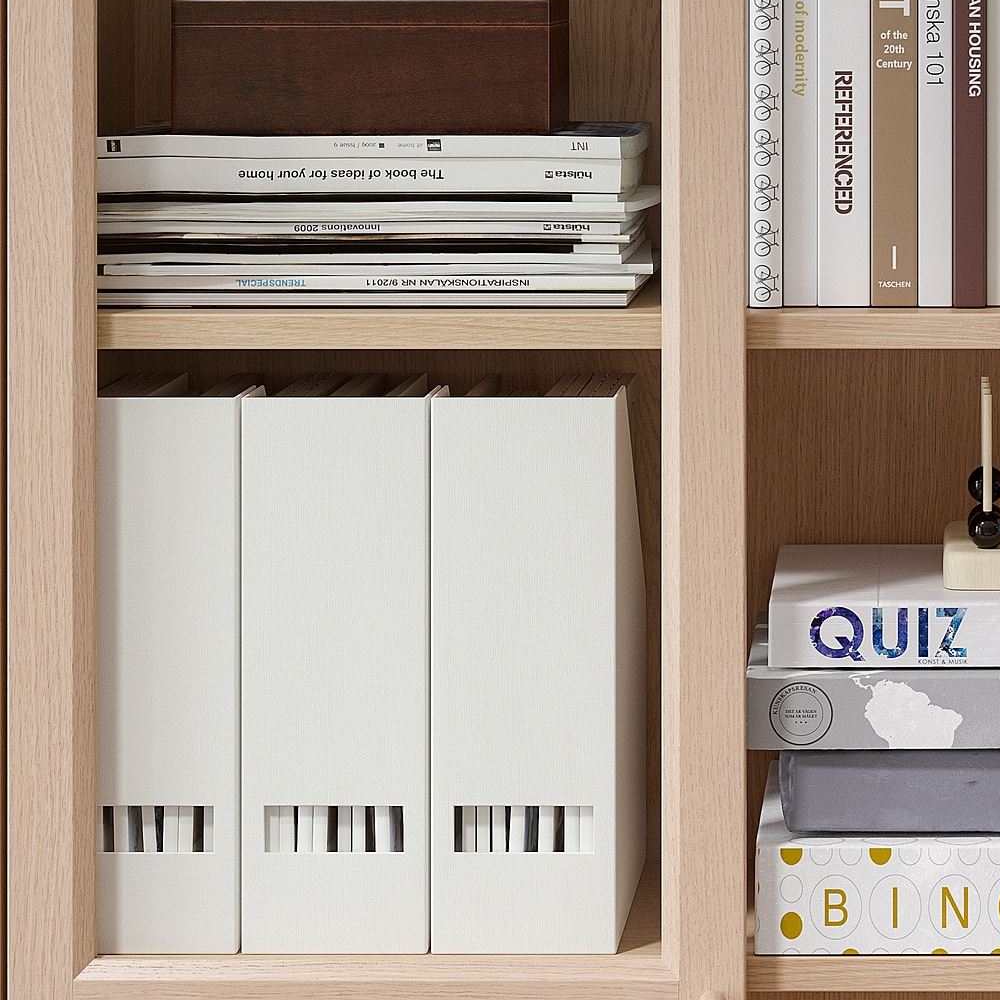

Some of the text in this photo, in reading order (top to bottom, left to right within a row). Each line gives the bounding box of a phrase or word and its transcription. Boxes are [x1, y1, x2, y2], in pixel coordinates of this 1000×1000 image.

[795, 1, 809, 16] of
[880, 30, 908, 40] of the
[884, 44, 905, 54] 20th
[791, 20, 809, 97] modernity
[876, 59, 912, 71] Century
[968, 22, 981, 98] HOUSING
[926, 52, 945, 86] 101
[570, 141, 589, 151] INT
[834, 70, 853, 215] REFERENCED
[238, 168, 592, 181] hülsta The book of ideas for your home
[293, 223, 590, 232] hülsta Innovations 2009
[235, 278, 530, 288] INSPIRATIONSKÄLAN NR 9/2011 TRENDSPECIAL
[809, 606, 968, 662] QUIZ
[772, 685, 818, 715] KUNSKAPSRESAN
